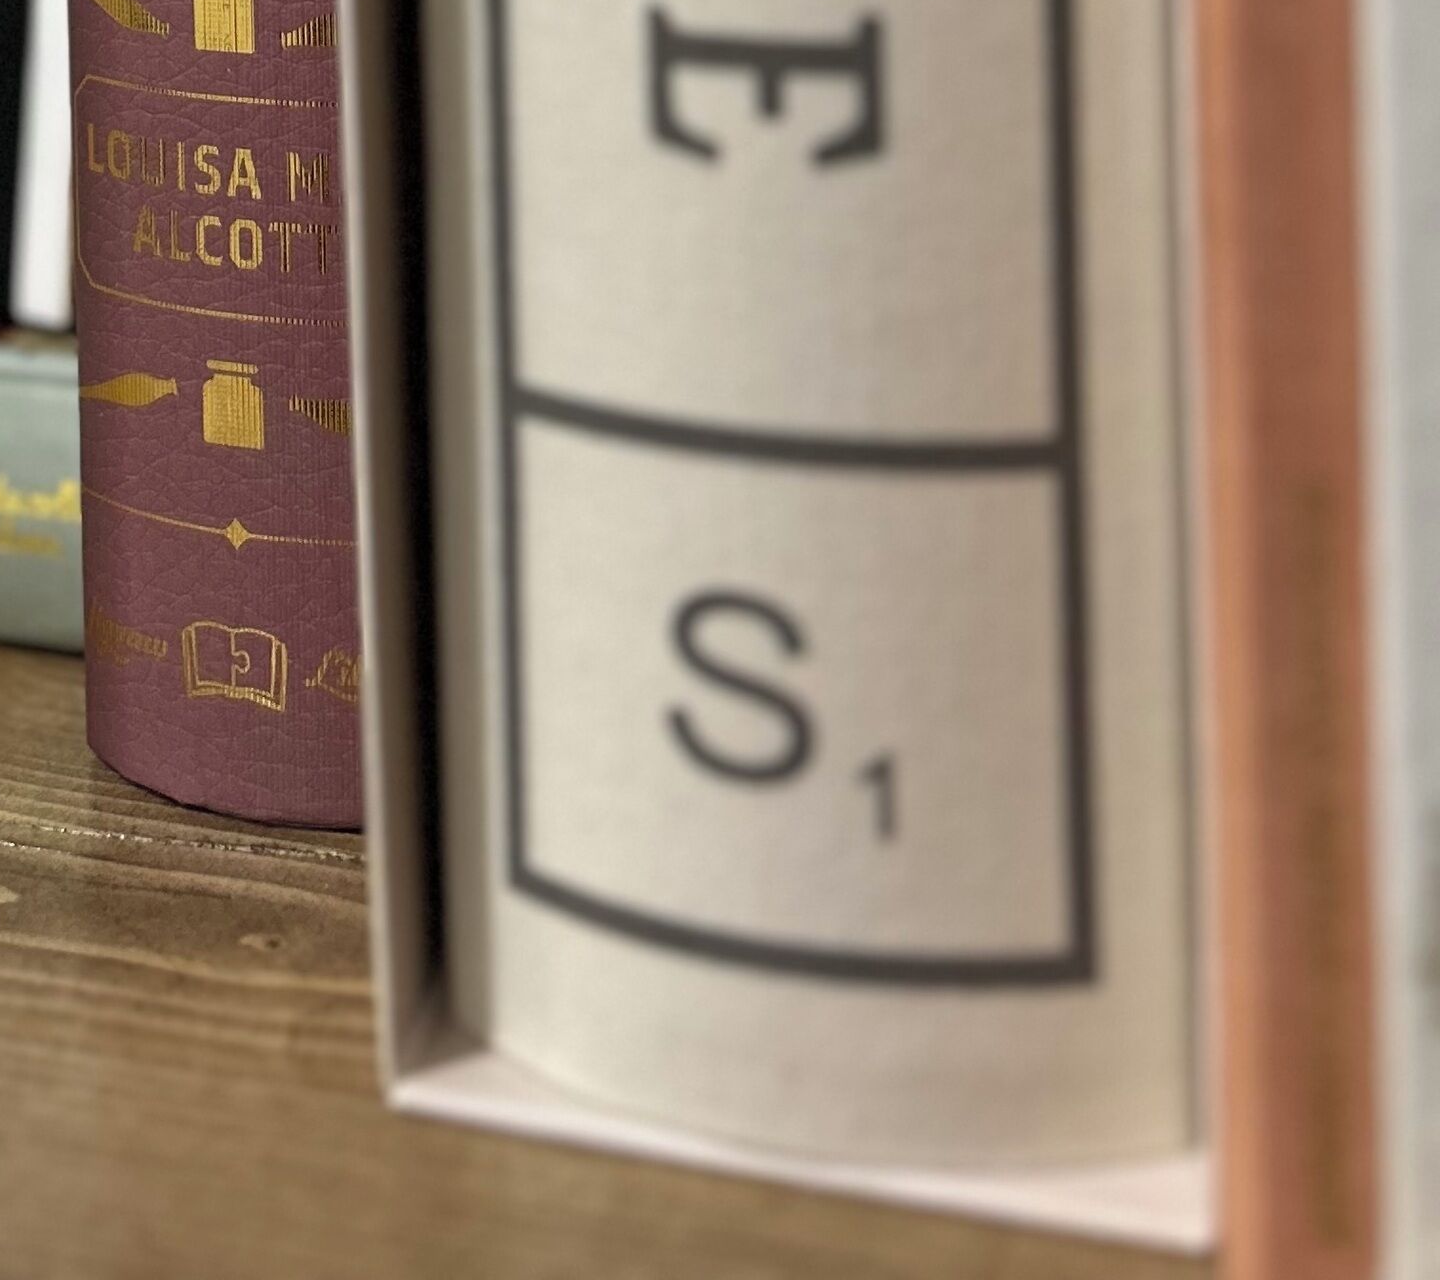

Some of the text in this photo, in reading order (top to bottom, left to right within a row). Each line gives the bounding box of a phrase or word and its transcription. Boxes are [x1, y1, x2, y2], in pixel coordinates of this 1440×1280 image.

[86, 123, 262, 200] LOUISA
[132, 205, 340, 276] ALCOTT
[665, 585, 820, 792] S
[858, 747, 899, 844] 1
